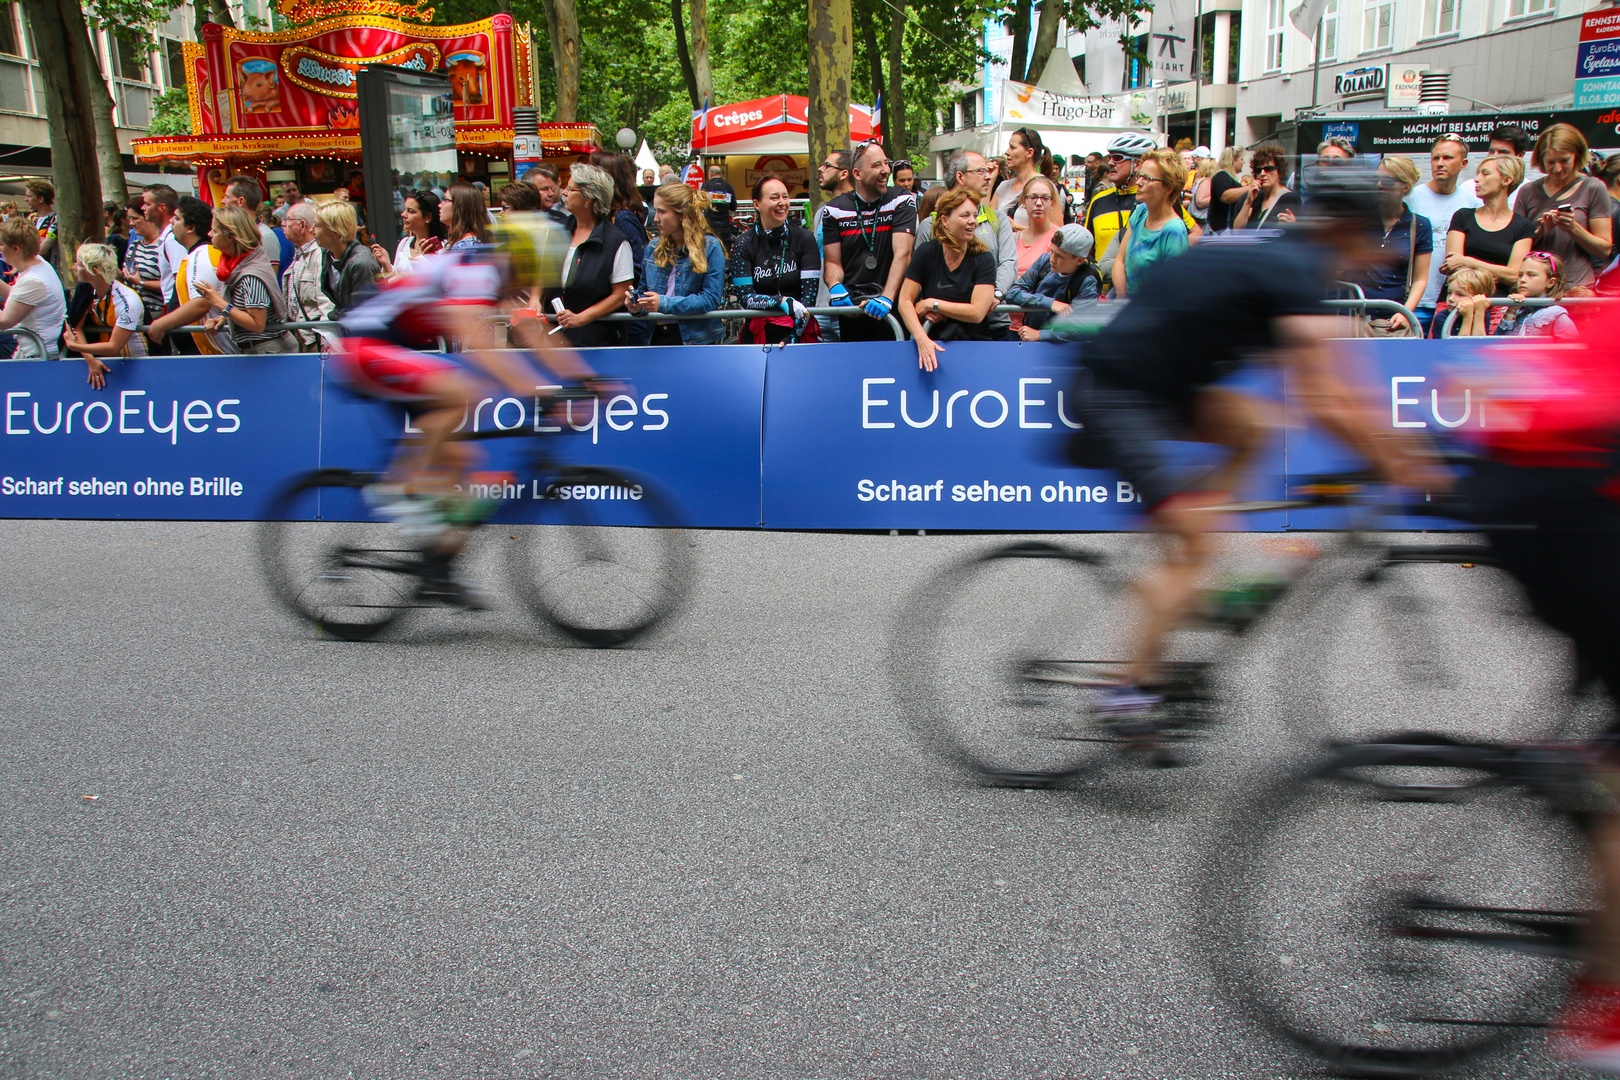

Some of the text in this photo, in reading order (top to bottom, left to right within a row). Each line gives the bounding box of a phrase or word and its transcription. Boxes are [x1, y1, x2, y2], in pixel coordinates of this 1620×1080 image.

[1335, 68, 1383, 95] ROLAND
[713, 110, 763, 128] Crêpes
[1042, 102, 1115, 121] Hugo-Bar
[1402, 123, 1430, 134] MACH
[1431, 122, 1448, 133] MIT
[1449, 122, 1463, 132] BEI
[1465, 121, 1495, 132] SAFER
[156, 144, 194, 153] Bratwurst
[213, 142, 280, 151] Riesen Krakauer
[299, 139, 357, 148] Pommes-frites
[1373, 137, 1388, 145] Bitte
[1388, 136, 1415, 144] beachte
[1415, 135, 1426, 144] die
[6, 390, 241, 445] EuroEyes
[1, 476, 243, 496] Scharf sehen ohne Brille
[469, 479, 526, 500] mehr
[857, 479, 944, 502] Scharf
[951, 480, 1032, 502] sehen
[1040, 480, 1108, 503] ohne
